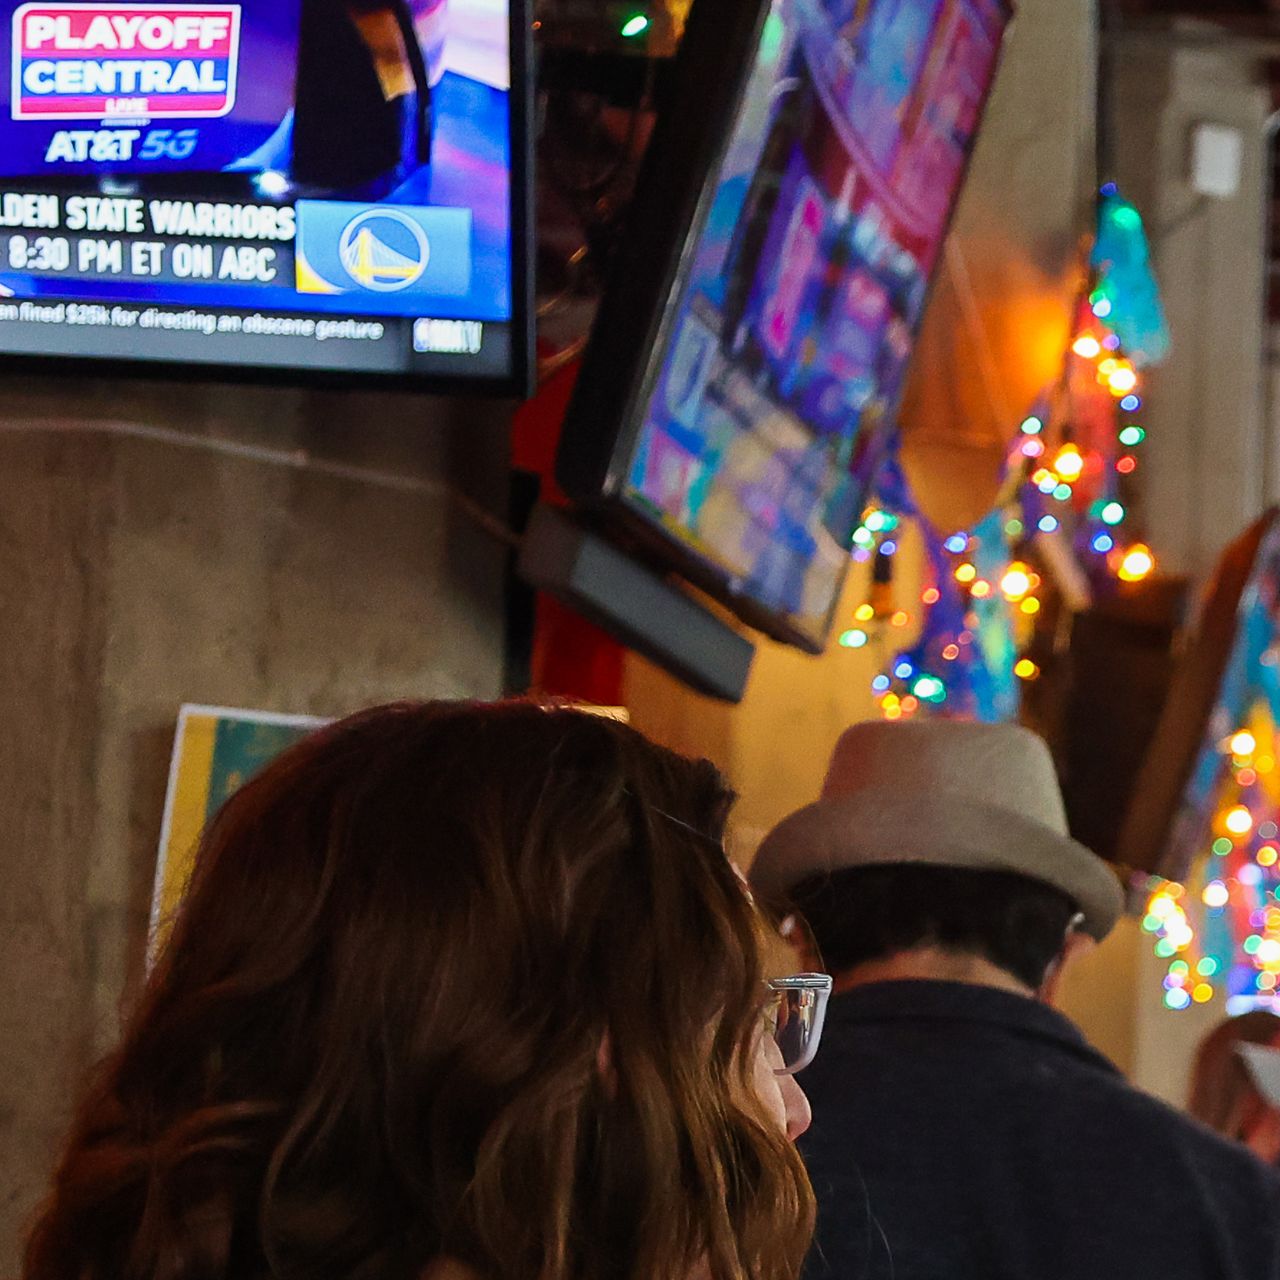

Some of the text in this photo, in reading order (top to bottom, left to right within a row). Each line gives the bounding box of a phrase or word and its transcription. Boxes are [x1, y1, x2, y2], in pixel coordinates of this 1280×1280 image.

[25, 15, 230, 50] PLAYOFF
[23, 60, 227, 94] CENTRAL
[44, 128, 199, 162] AT&T 5G
[65, 196, 145, 233] STATE
[149, 200, 297, 241] WARRIORS
[8, 234, 277, 282] 8:30 PM ET ON ABC
[19, 301, 66, 323] fined
[110, 306, 140, 327] for
[138, 308, 217, 335] directing
[216, 315, 242, 333] an
[242, 313, 316, 337] obscene
[315, 319, 385, 341] gesture
